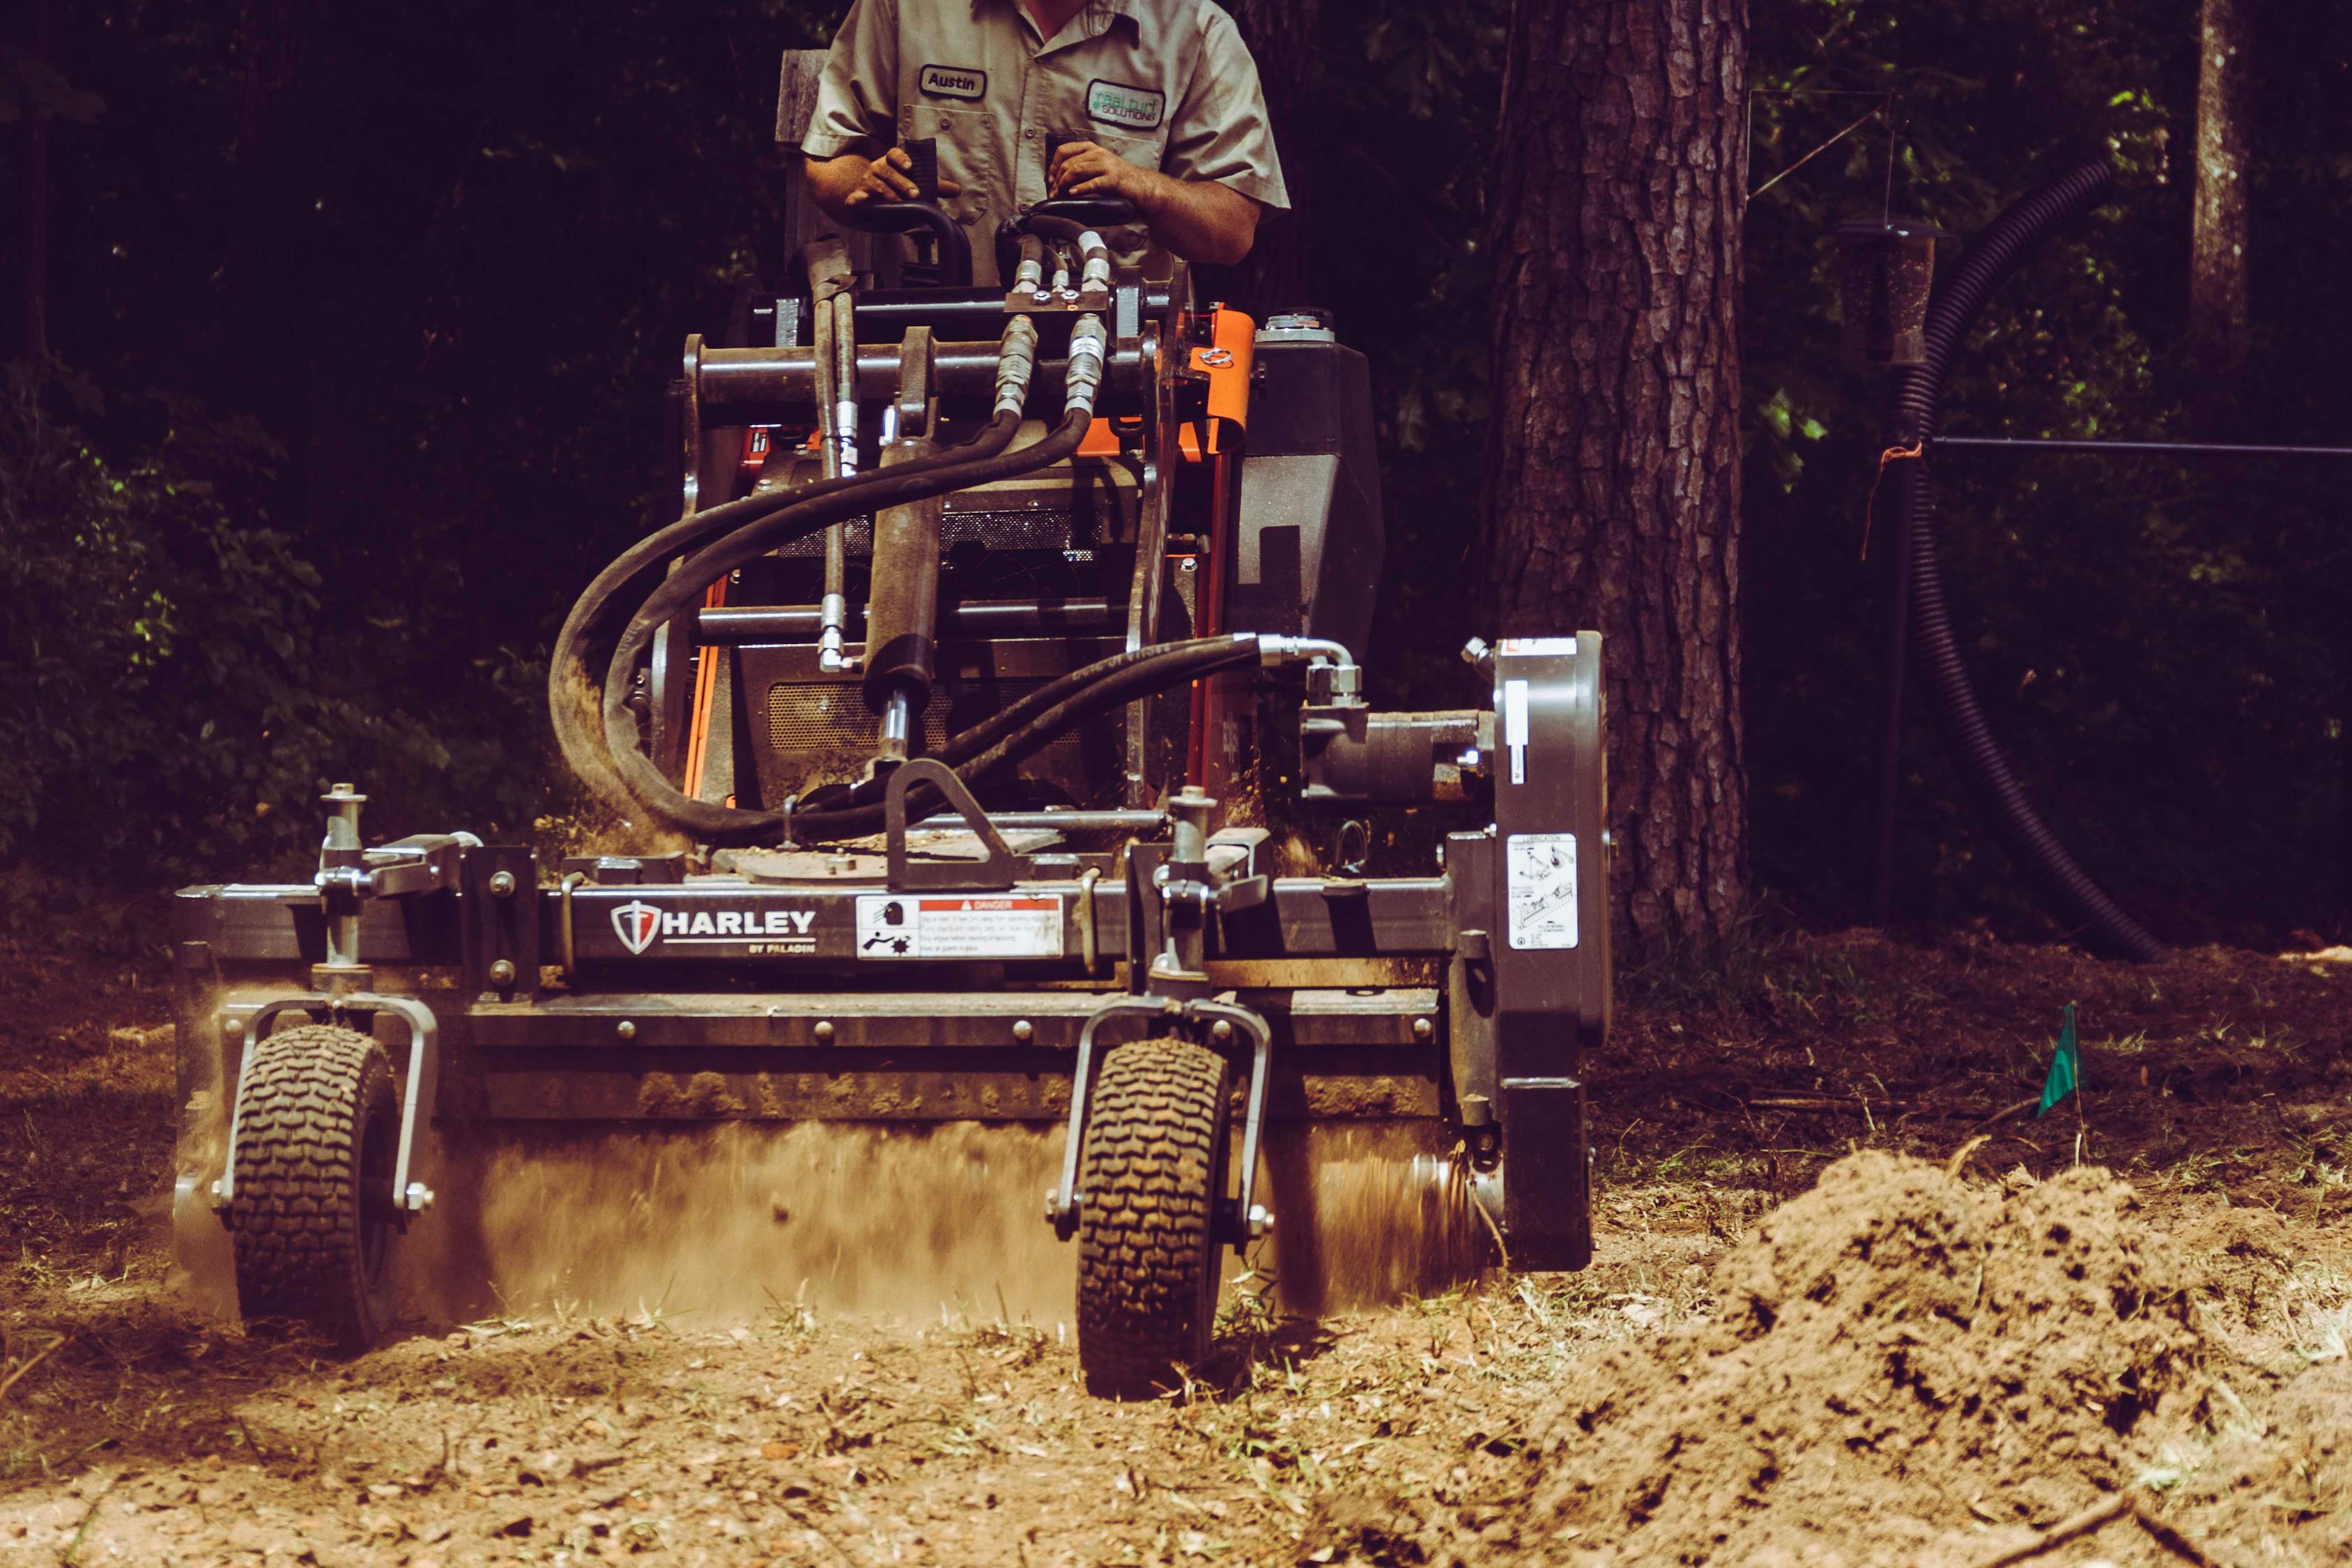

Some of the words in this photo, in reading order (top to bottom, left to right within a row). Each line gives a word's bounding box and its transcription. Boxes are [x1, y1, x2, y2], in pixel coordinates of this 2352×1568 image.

[928, 72, 975, 91] Austin
[1096, 91, 1126, 107] real
[1129, 98, 1160, 113] turf
[1102, 105, 1157, 121] SOLUTIONS
[974, 900, 1013, 910] DANGER
[662, 910, 817, 935] HARLEY
[748, 944, 764, 954] BY
